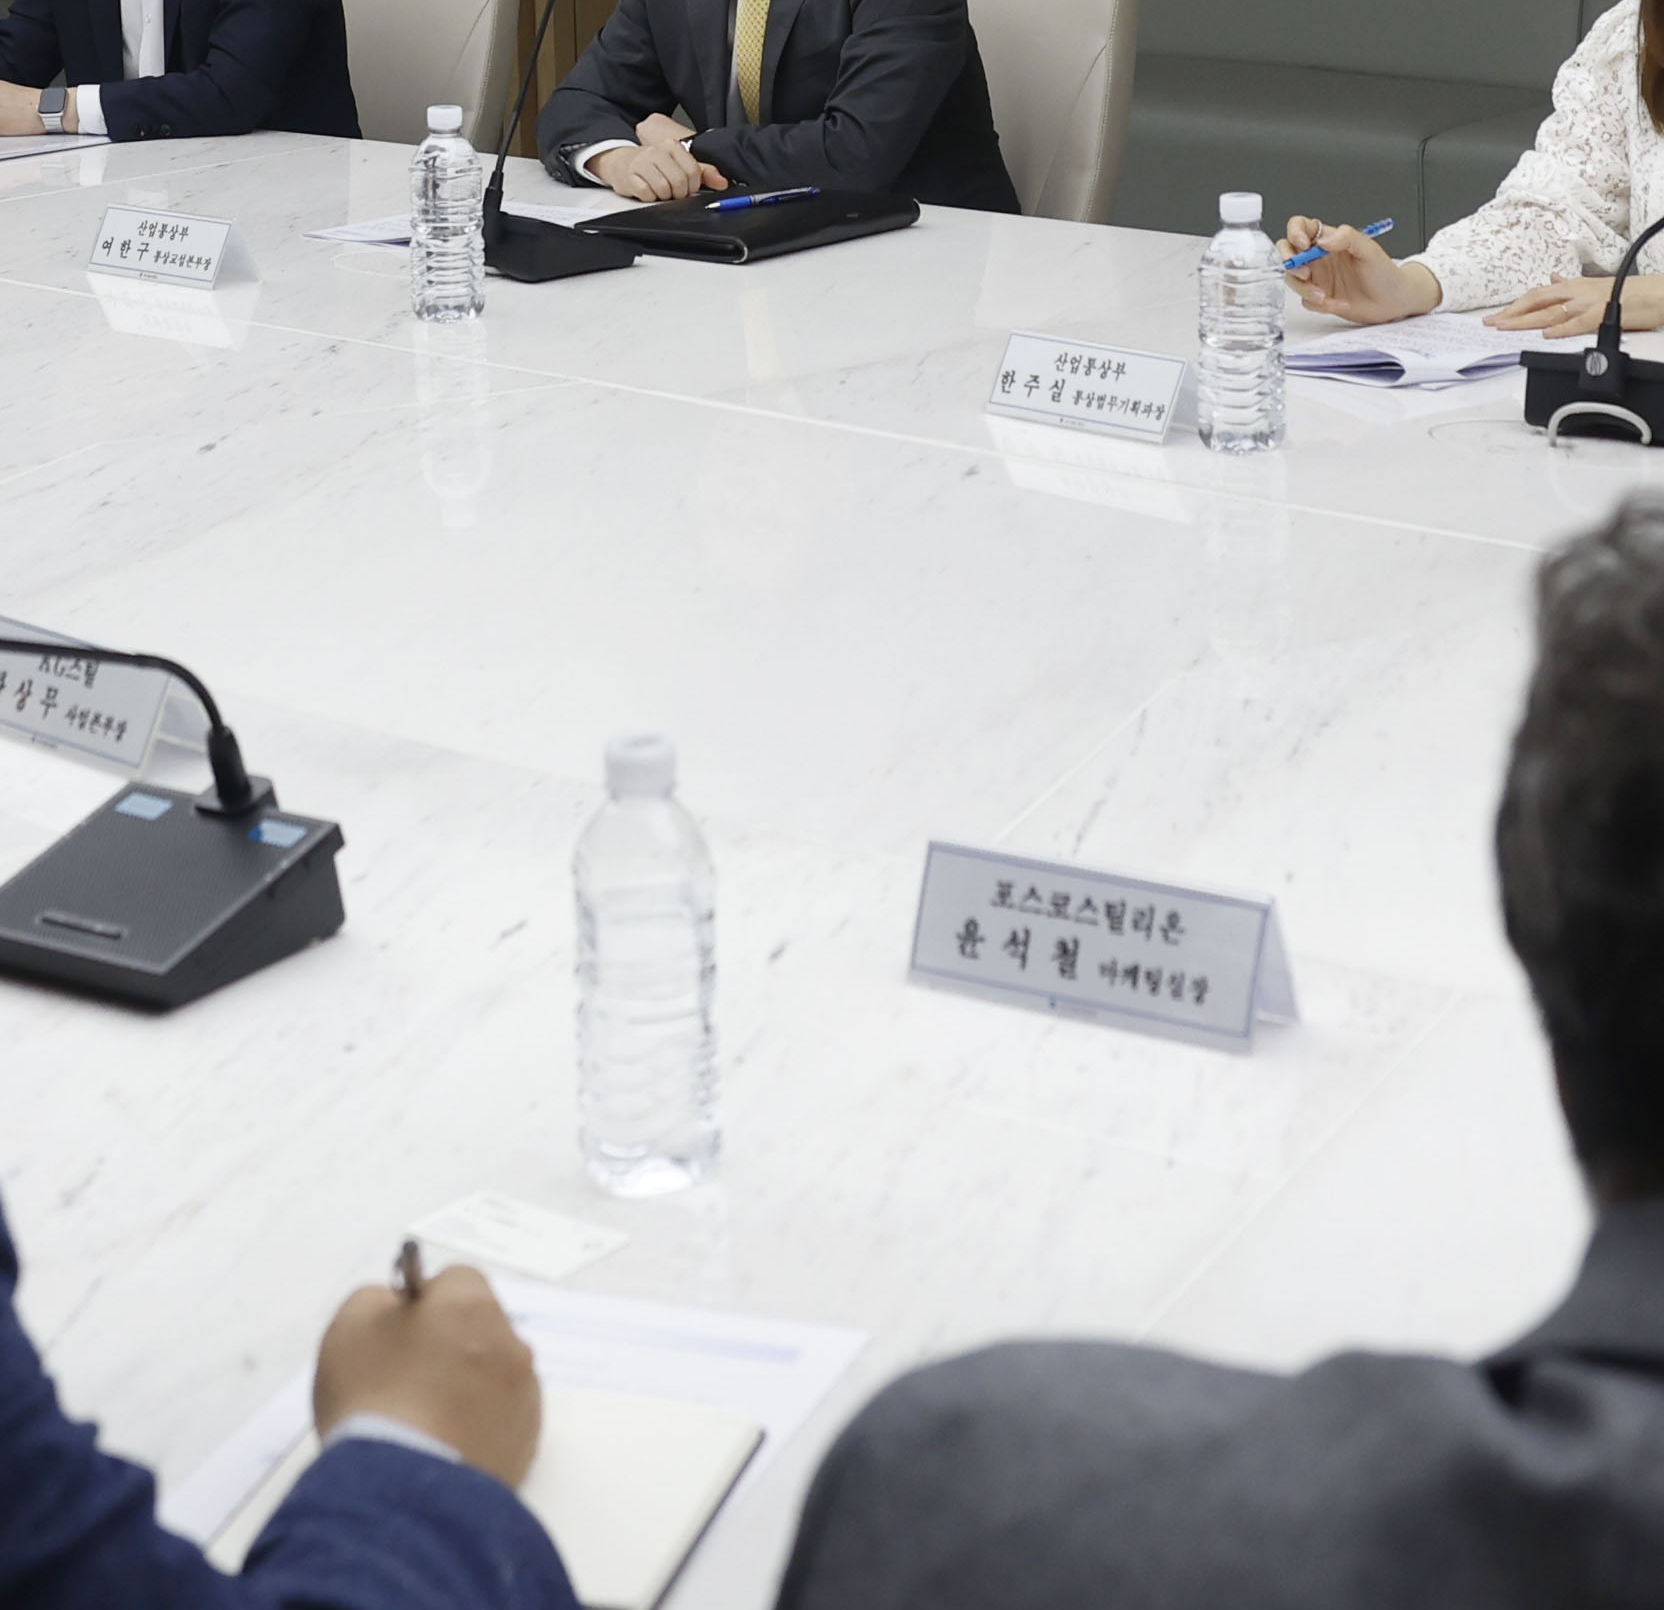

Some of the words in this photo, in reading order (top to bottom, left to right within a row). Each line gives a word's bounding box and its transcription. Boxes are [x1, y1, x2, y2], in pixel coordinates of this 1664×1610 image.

[137, 220, 189, 242] 산업통상부
[154, 250, 211, 271] 통상교섭본부장
[1054, 352, 1127, 382] 산업통상부
[1072, 389, 1166, 421] 통상법무기획과장
